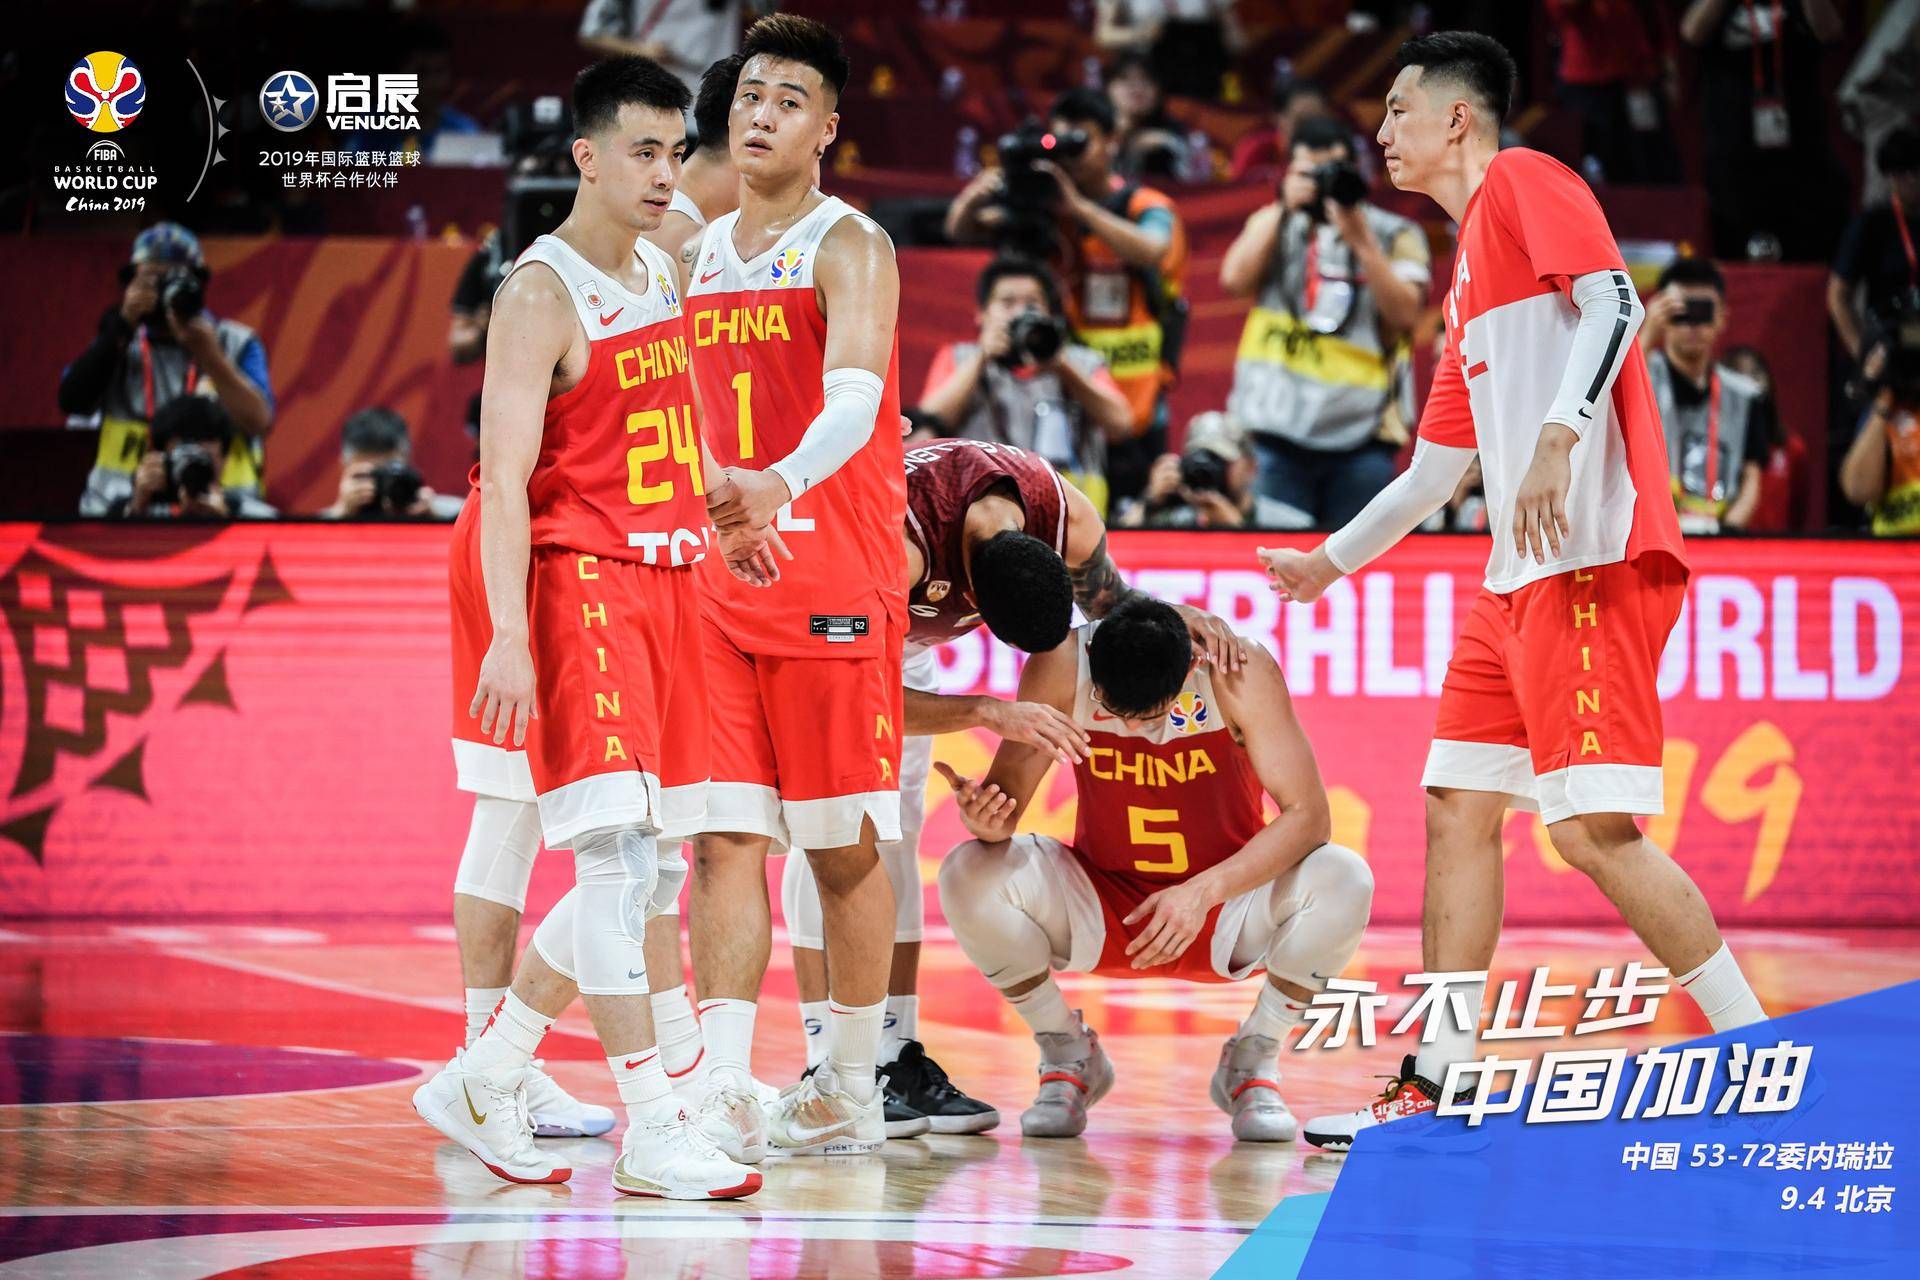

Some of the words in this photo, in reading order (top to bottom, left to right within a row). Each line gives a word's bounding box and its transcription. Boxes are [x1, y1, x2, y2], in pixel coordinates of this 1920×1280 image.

[694, 304, 791, 347] CHINA
[731, 371, 754, 460] 1
[626, 404, 705, 505] 24
[627, 527, 710, 567] TC
[855, 621, 865, 630] 52
[577, 555, 628, 762] CHINA
[1089, 747, 1217, 787] CHINA
[1127, 805, 1189, 874] 5
